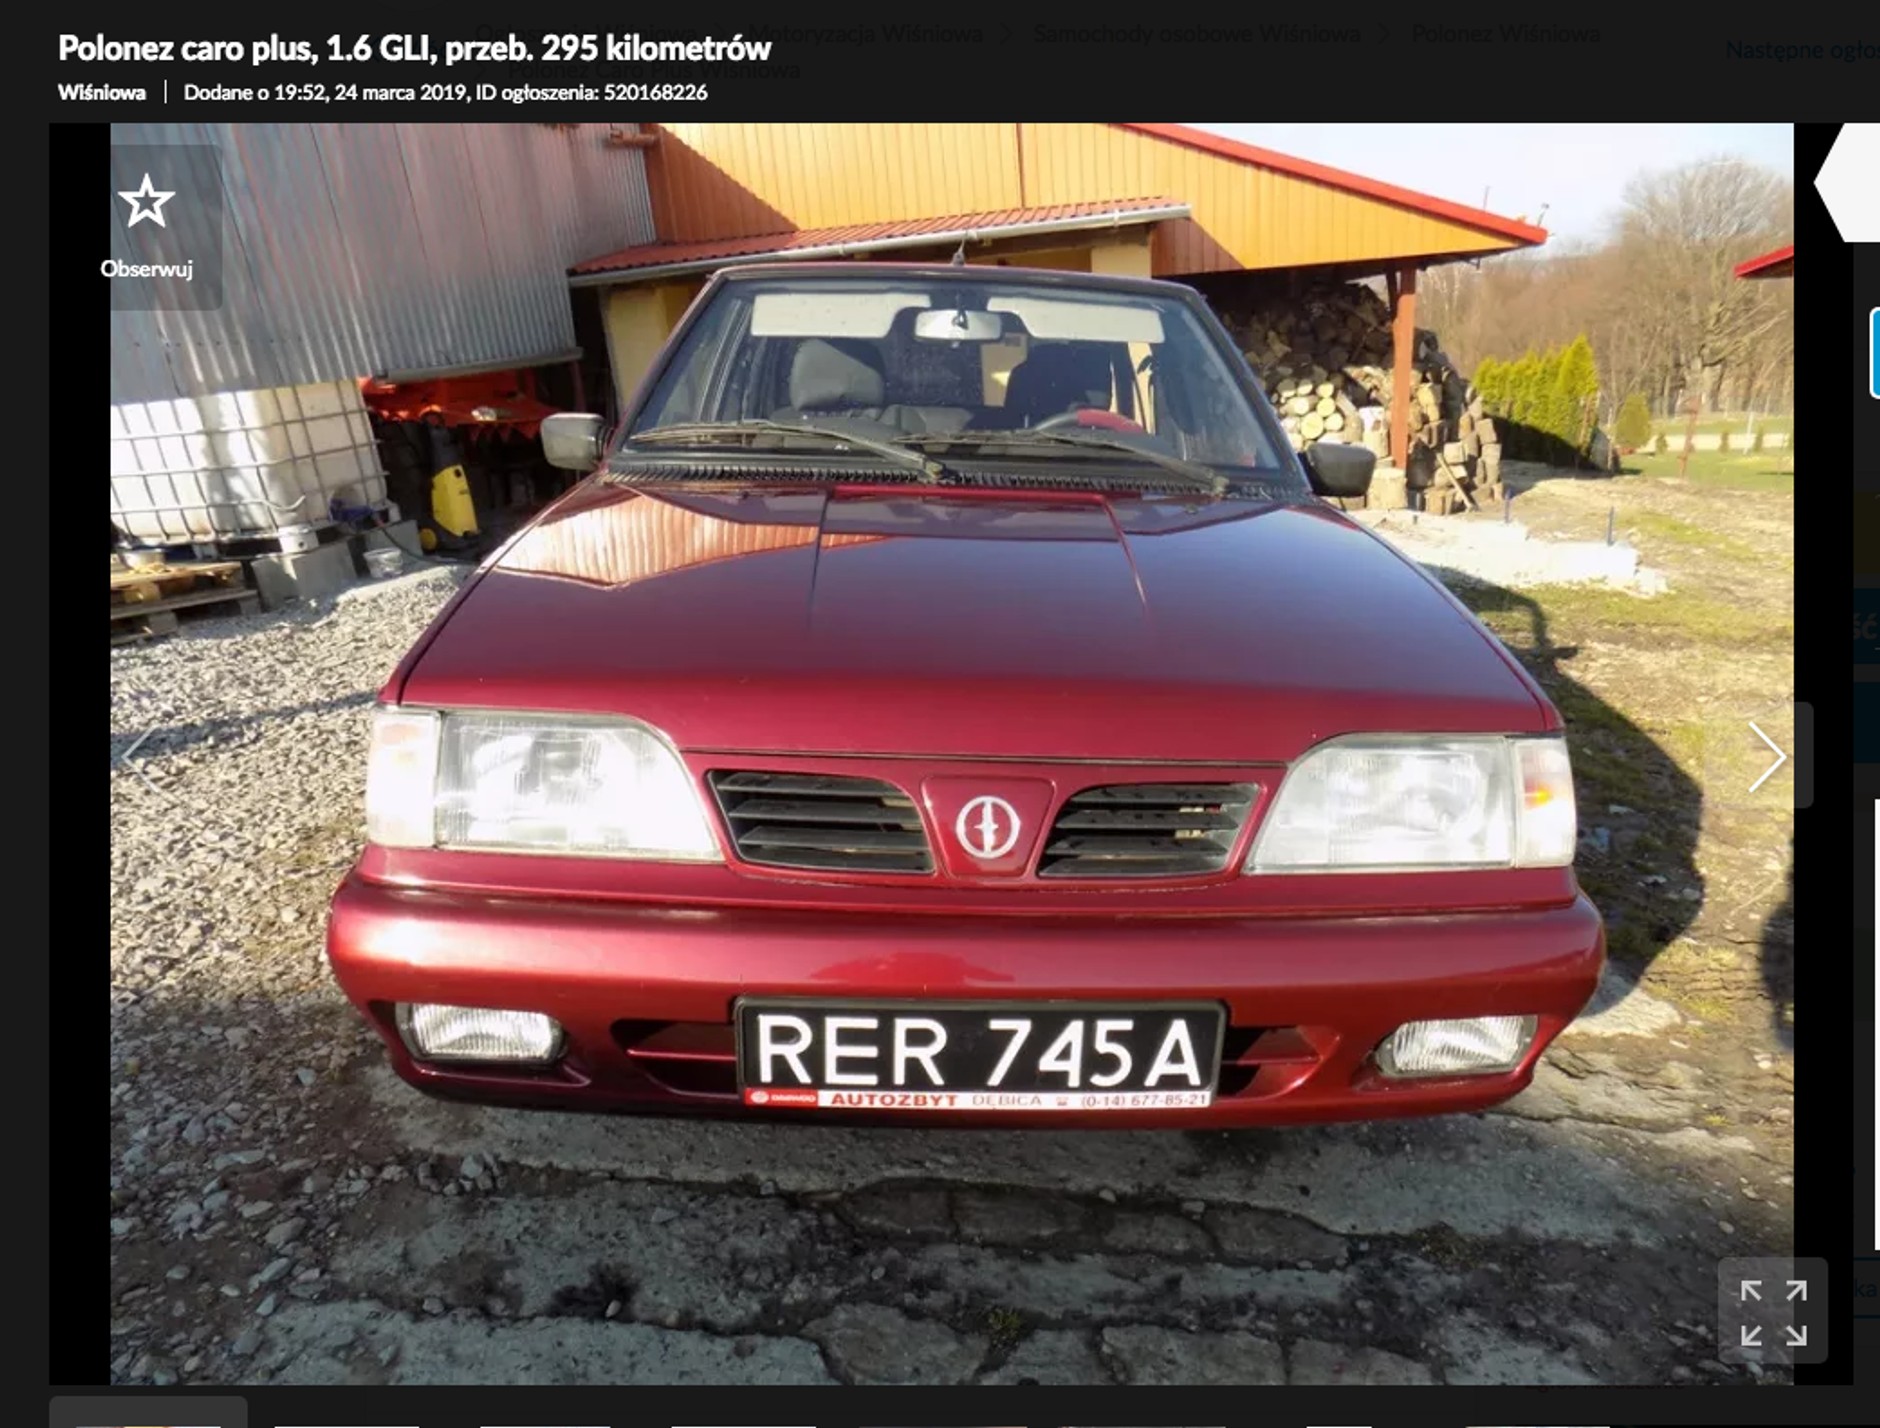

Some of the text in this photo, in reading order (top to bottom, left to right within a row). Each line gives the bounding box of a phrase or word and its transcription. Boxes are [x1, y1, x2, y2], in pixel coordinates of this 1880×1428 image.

[758, 1014, 1201, 1088] RER 745A
[831, 1092, 958, 1107] AUTOZBYT
[1081, 1094, 1125, 1107] (0-14)
[1131, 1093, 1206, 1106] 677-85-21
